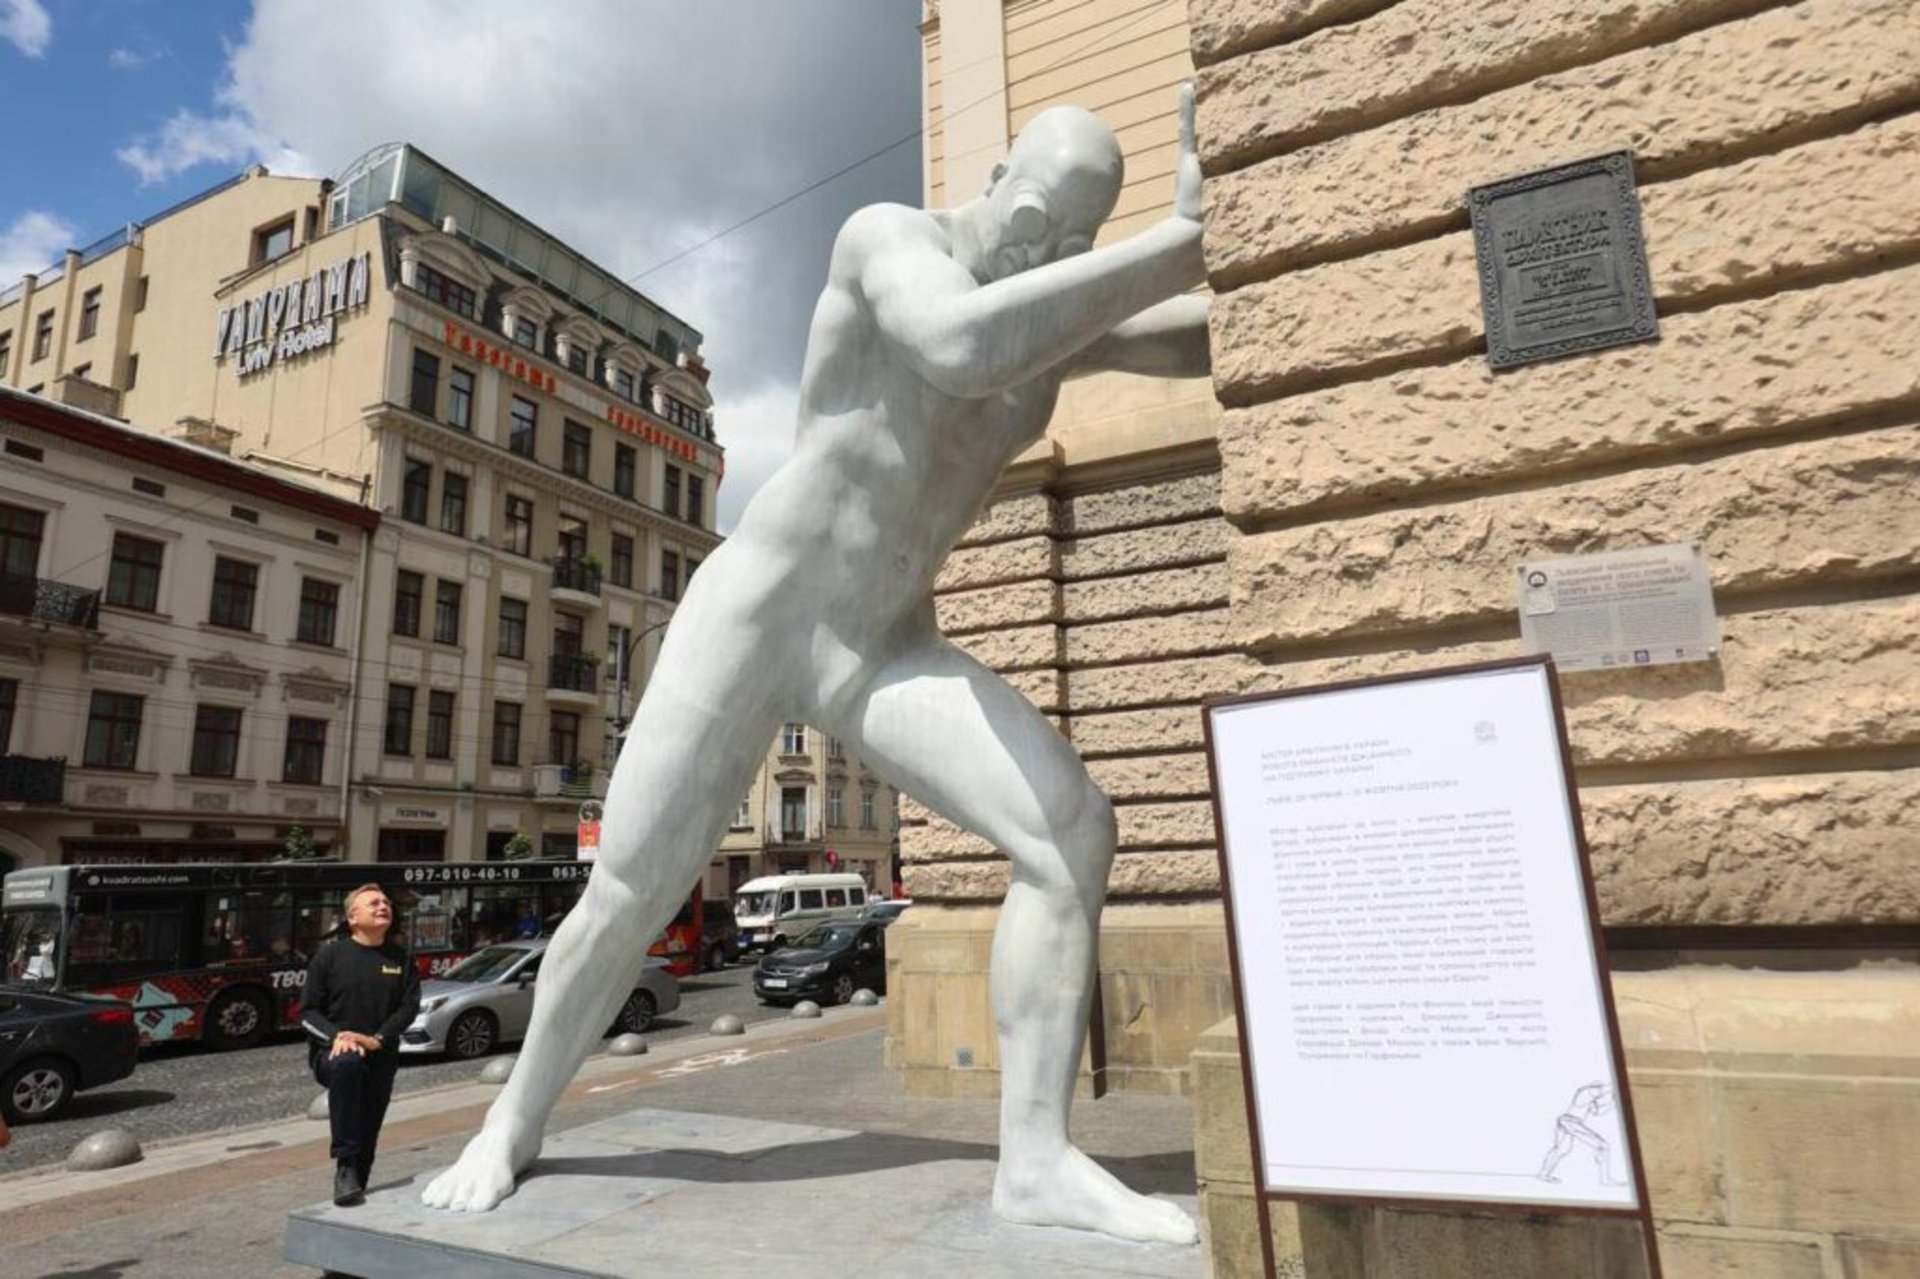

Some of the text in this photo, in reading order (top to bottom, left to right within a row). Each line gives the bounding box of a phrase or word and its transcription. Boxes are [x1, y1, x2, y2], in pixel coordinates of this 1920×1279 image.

[235, 316, 334, 376] Lviv Hotel
[404, 867, 520, 882] 097-010-40-10
